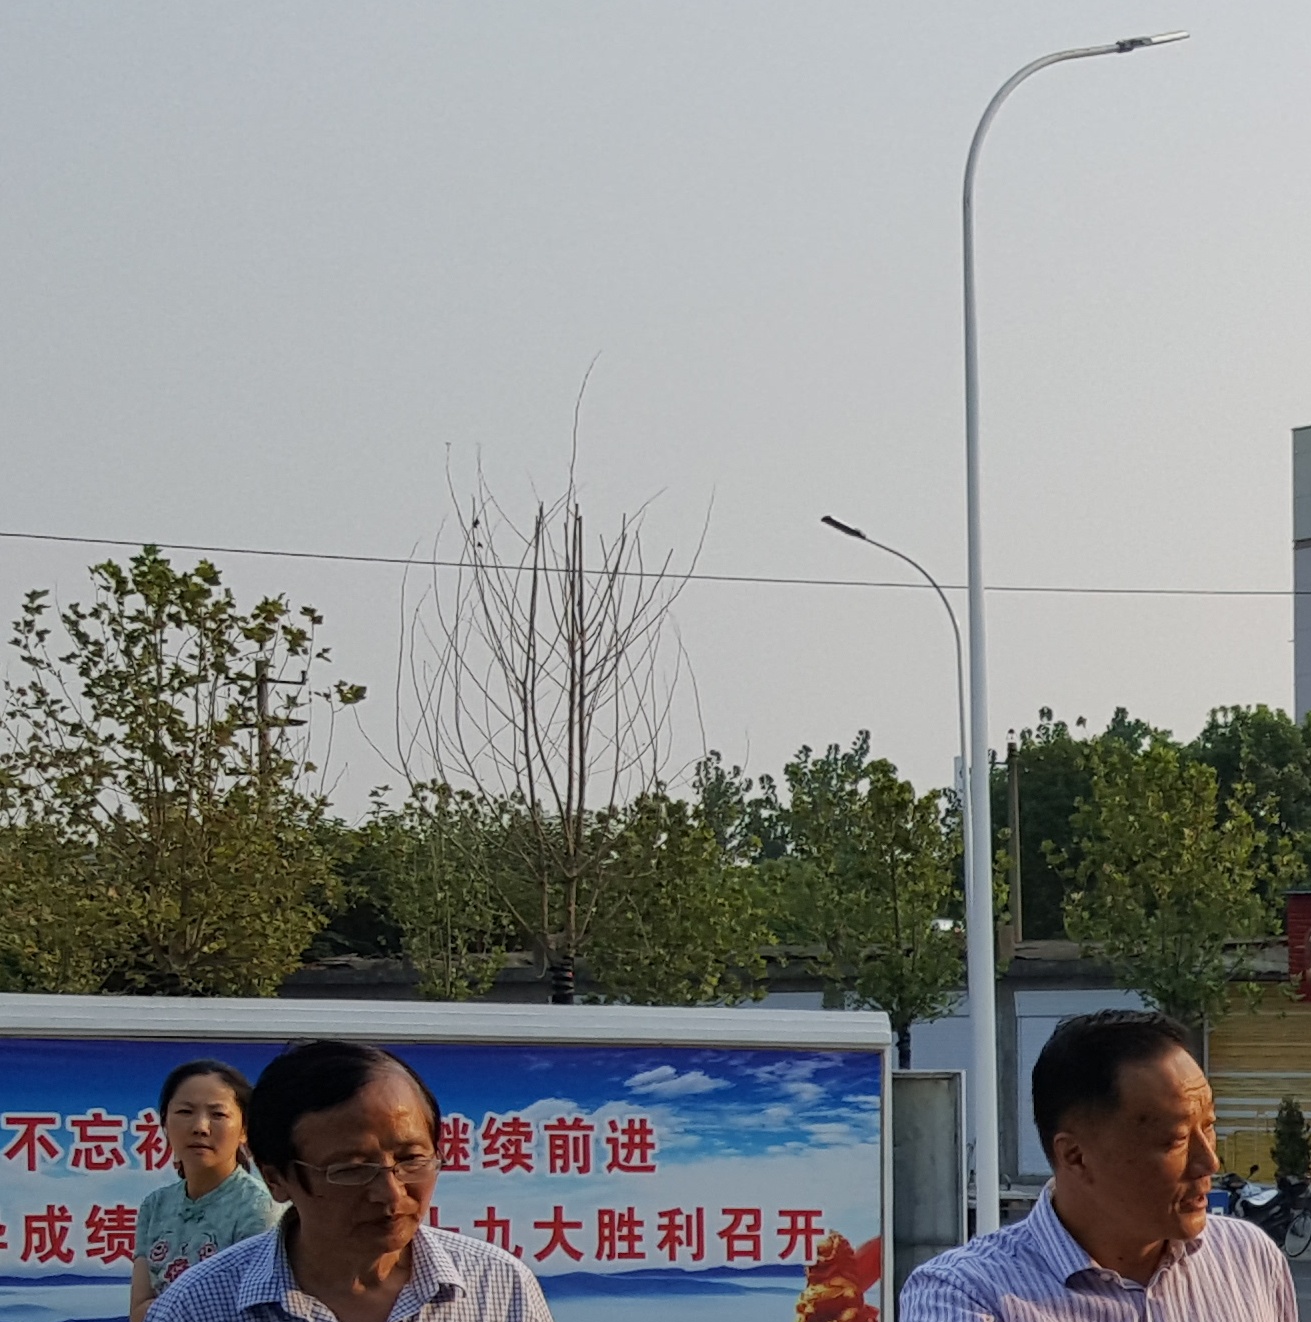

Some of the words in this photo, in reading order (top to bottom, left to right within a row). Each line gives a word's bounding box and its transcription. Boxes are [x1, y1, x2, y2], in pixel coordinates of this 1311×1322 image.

[438, 1117, 656, 1174] 继续前进
[0, 1204, 138, 1264] 成绩
